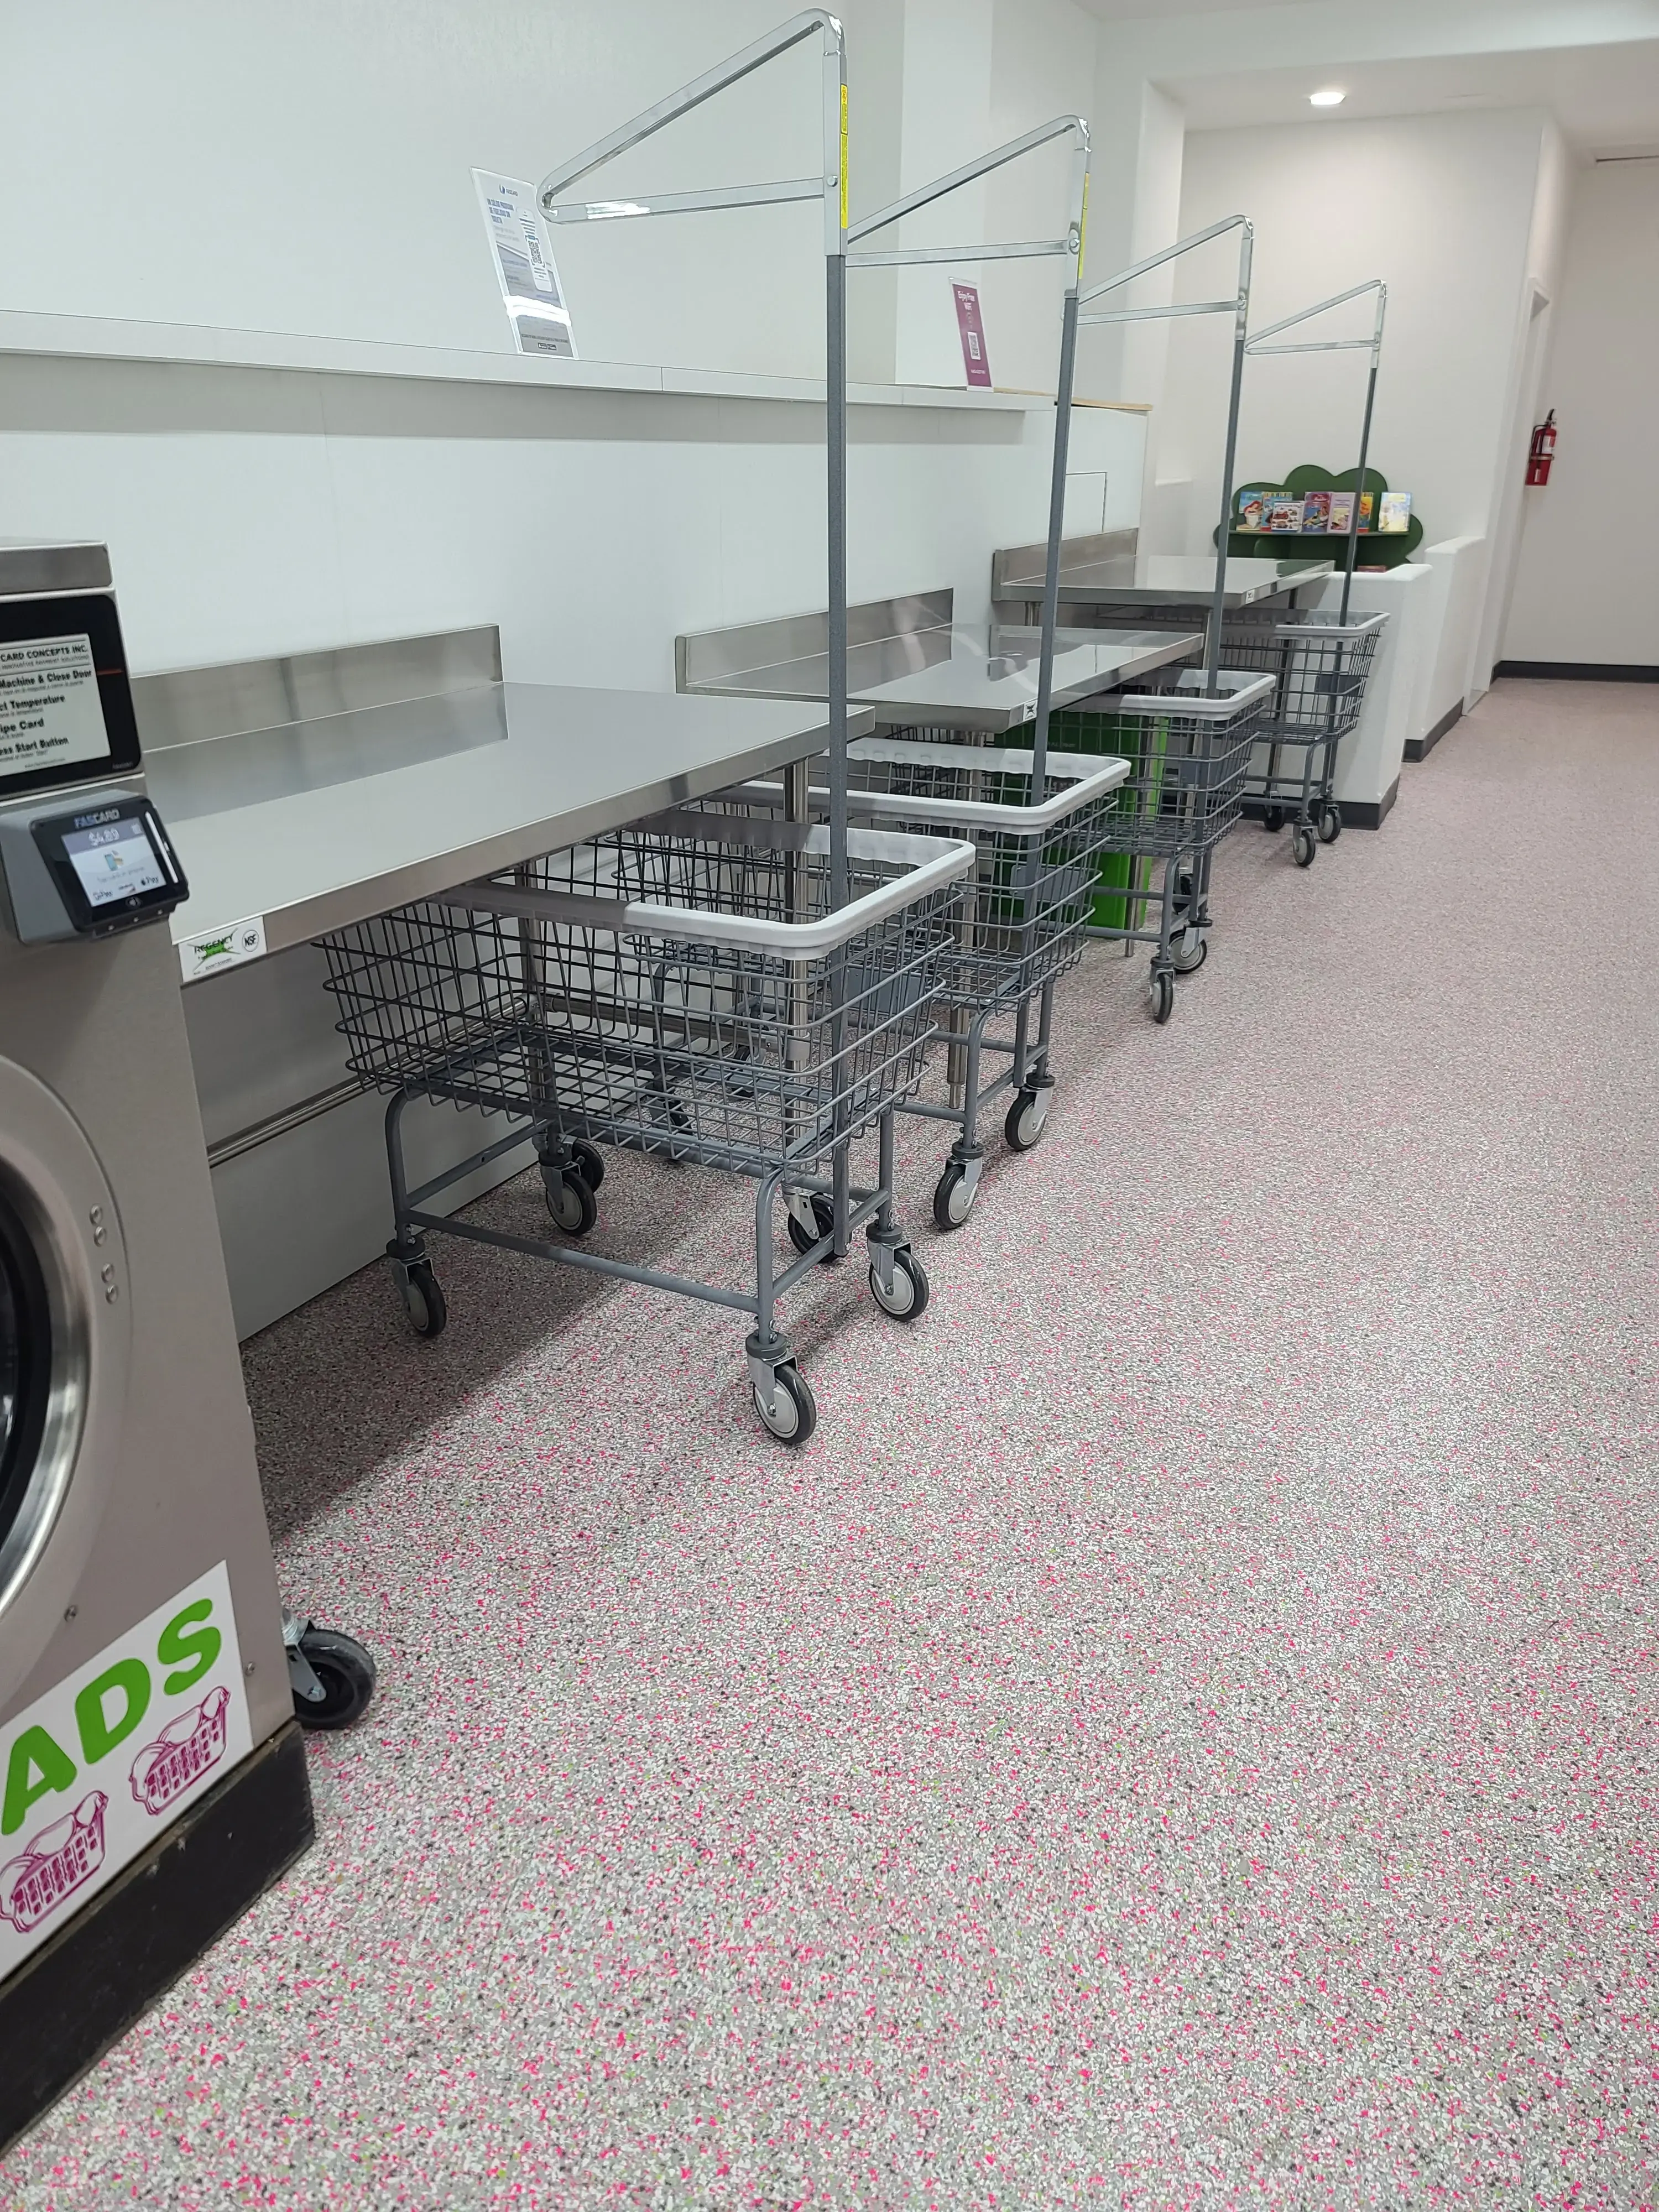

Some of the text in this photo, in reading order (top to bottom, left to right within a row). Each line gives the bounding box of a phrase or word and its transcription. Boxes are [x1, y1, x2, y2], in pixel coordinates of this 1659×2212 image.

[0, 653, 24, 662] CARD
[26, 646, 70, 659] CONCEPTS
[38, 674, 44, 684] &
[47, 671, 70, 682] Close
[72, 669, 91, 679] Door
[9, 695, 65, 709] Temperature
[19, 717, 45, 731] Card
[15, 740, 38, 753] Start
[39, 736, 69, 748] Button
[74, 808, 120, 829] FASCARD
[194, 933, 233, 954] REGENCY
[244, 933, 257, 947] NSF
